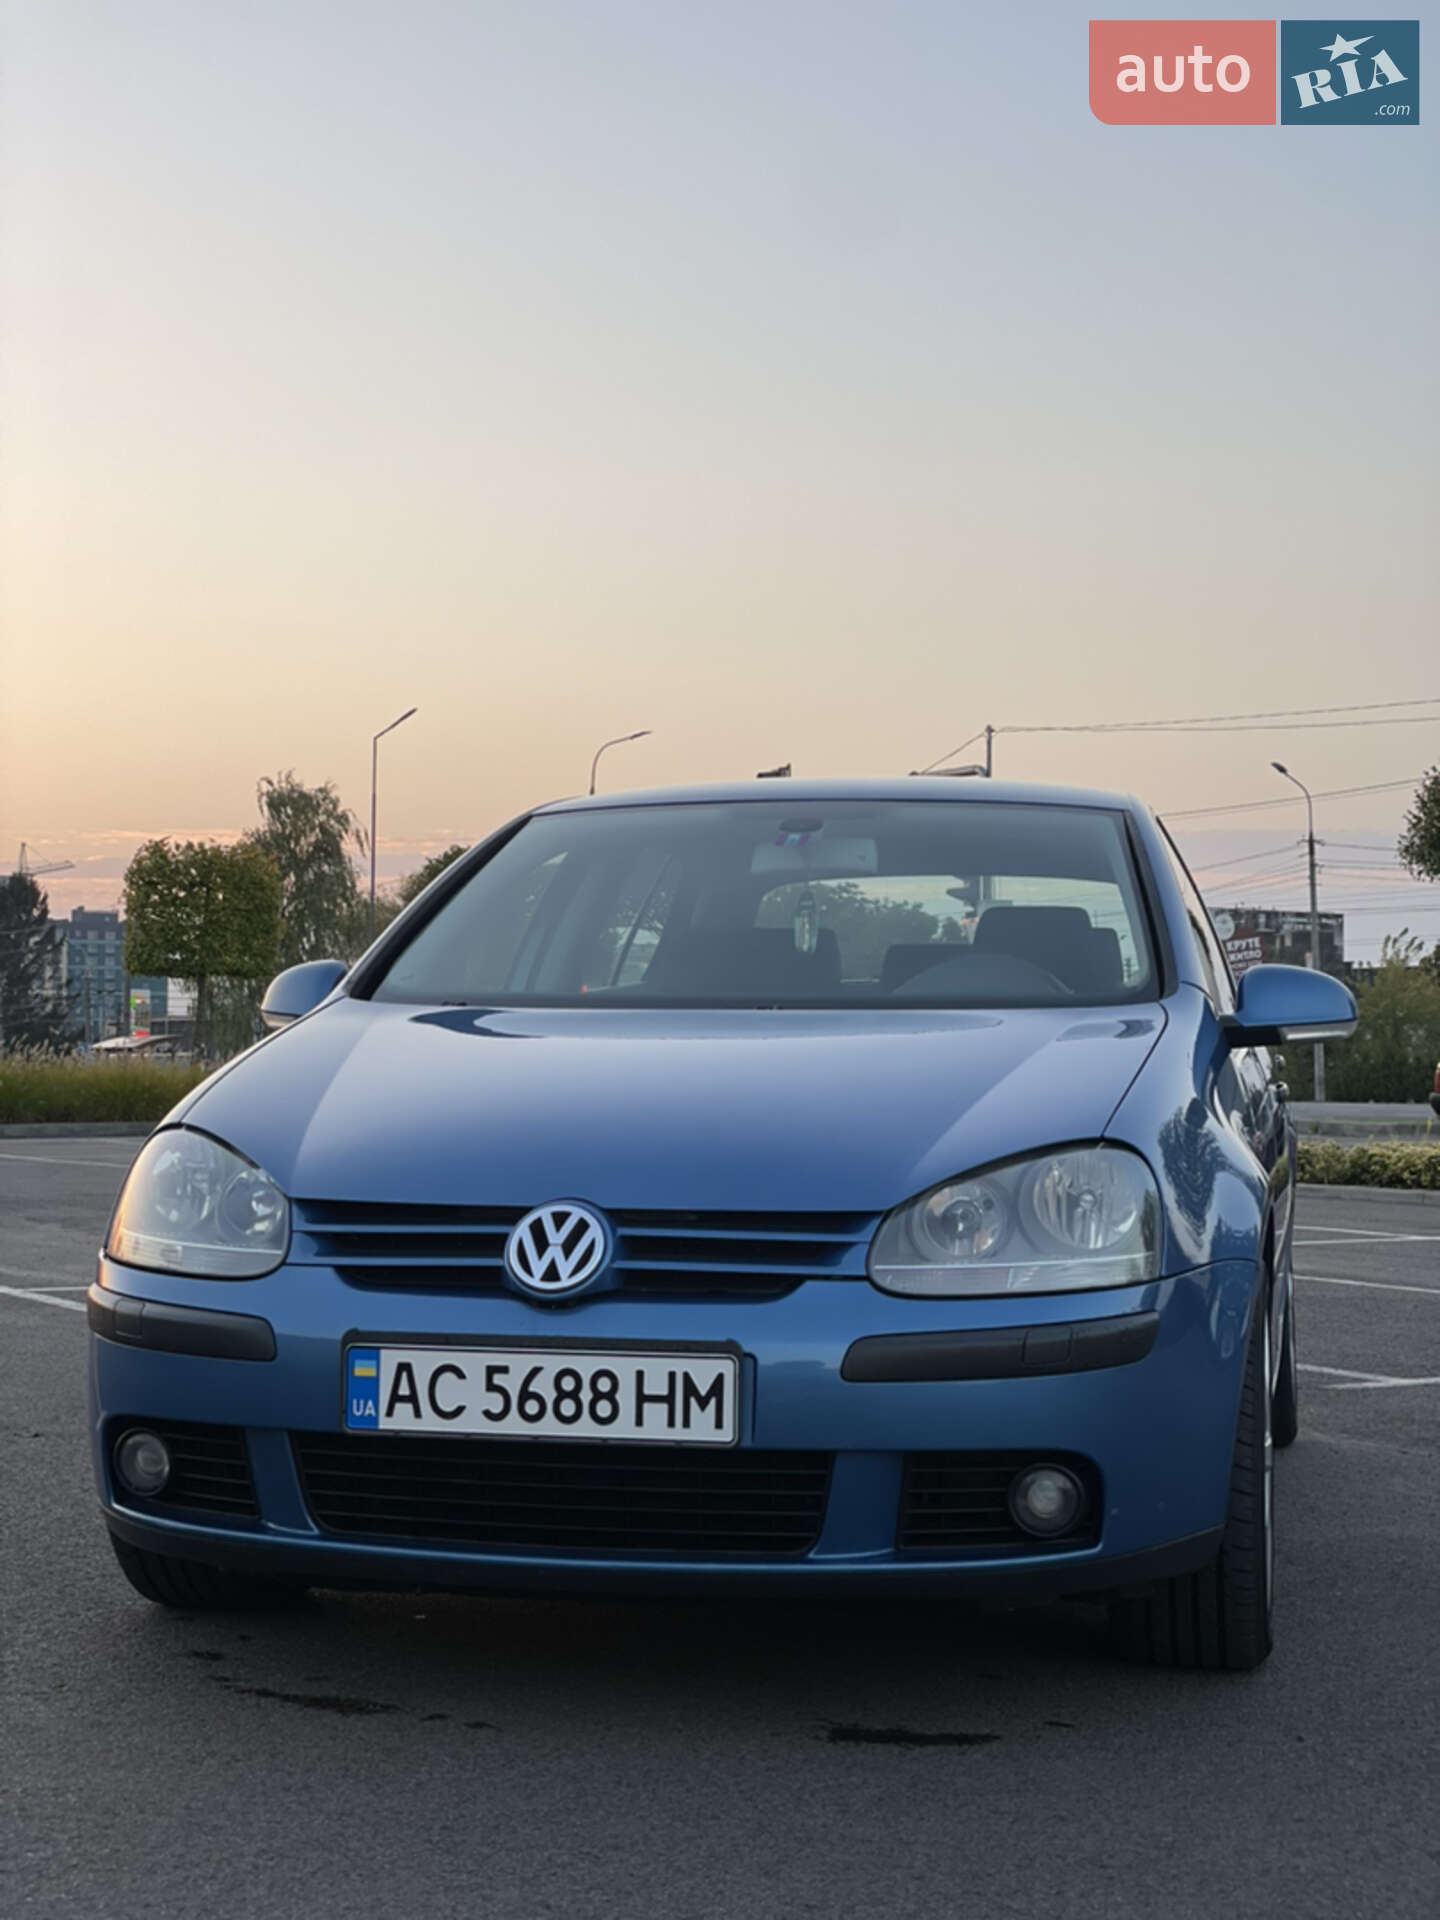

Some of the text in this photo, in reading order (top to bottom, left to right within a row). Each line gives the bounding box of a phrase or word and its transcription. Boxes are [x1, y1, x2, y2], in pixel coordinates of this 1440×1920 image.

[510, 1204, 604, 1289] VW
[352, 1398, 376, 1416] UA
[384, 1361, 725, 1430] AC 5688 HM
